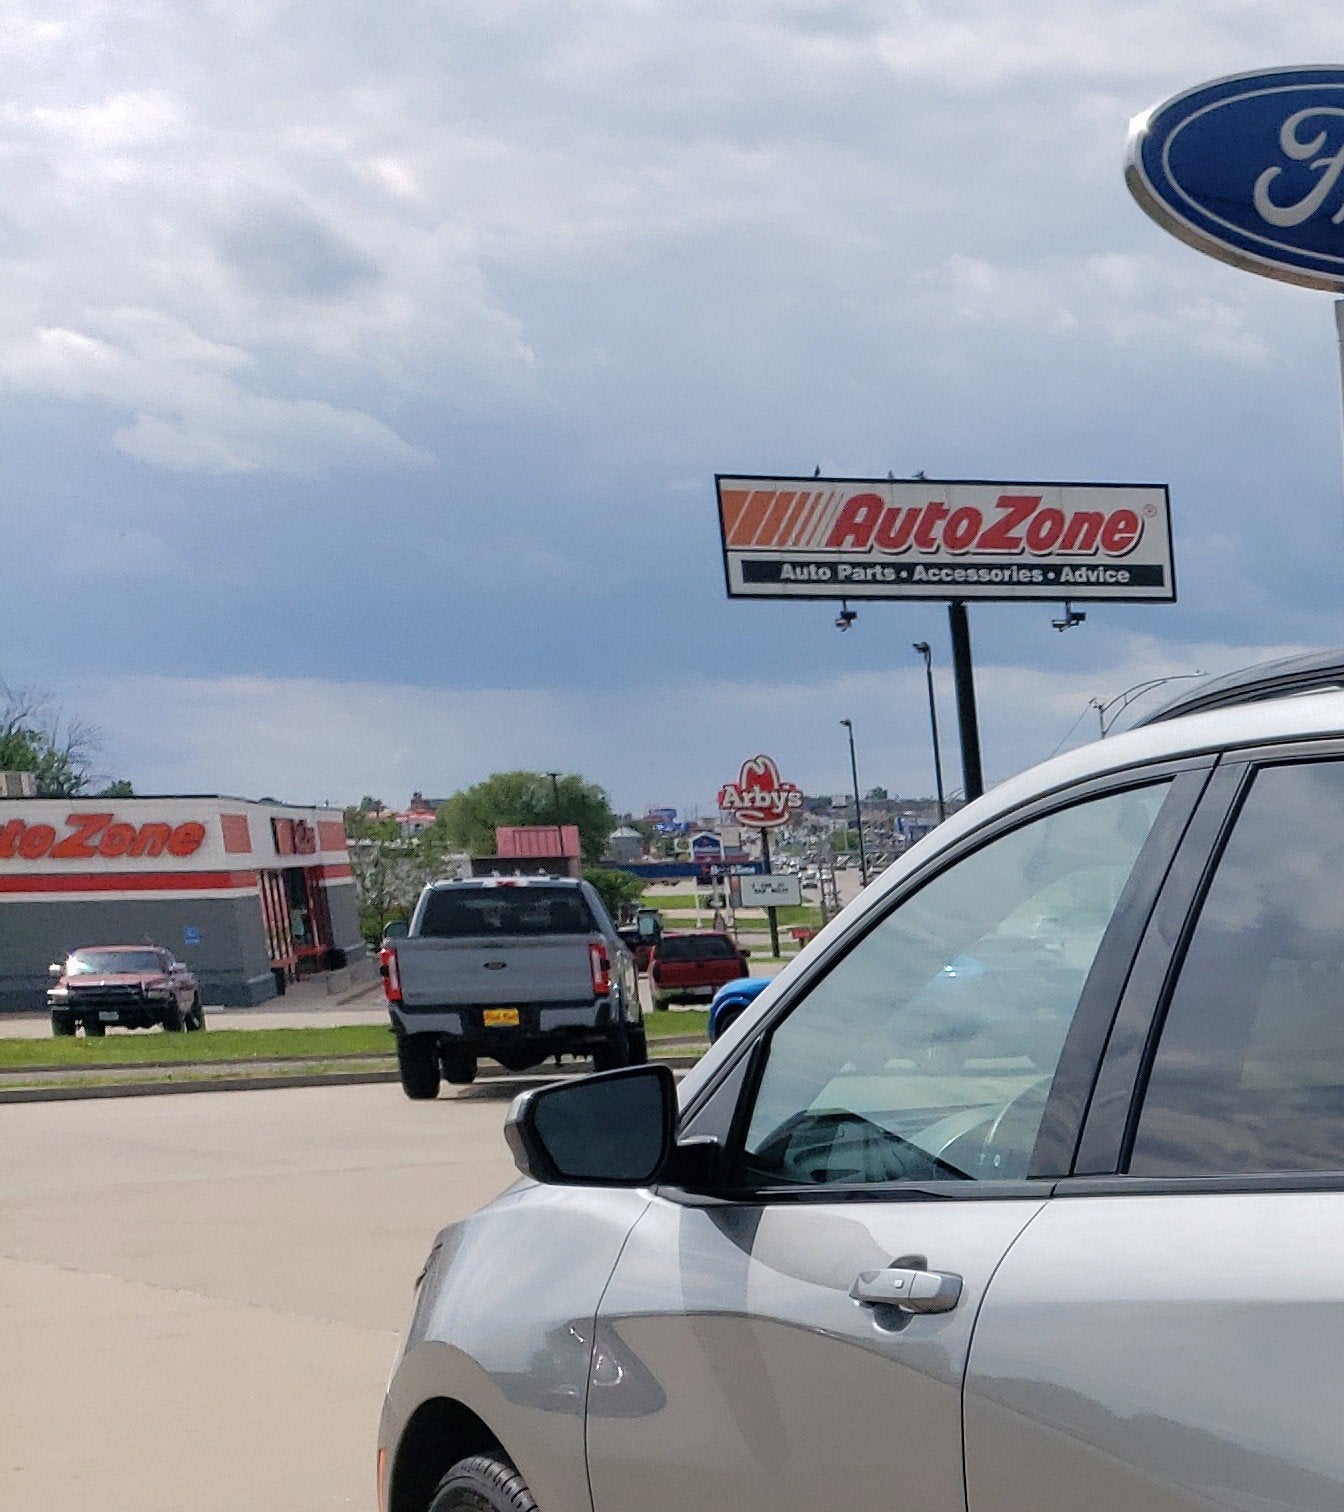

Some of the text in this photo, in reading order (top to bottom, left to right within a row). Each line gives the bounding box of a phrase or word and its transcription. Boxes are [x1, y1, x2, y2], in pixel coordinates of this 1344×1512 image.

[825, 492, 1144, 556] AutoZone
[780, 562, 1131, 584] Auto Parts Accessories Advice
[722, 784, 803, 813] Arby's
